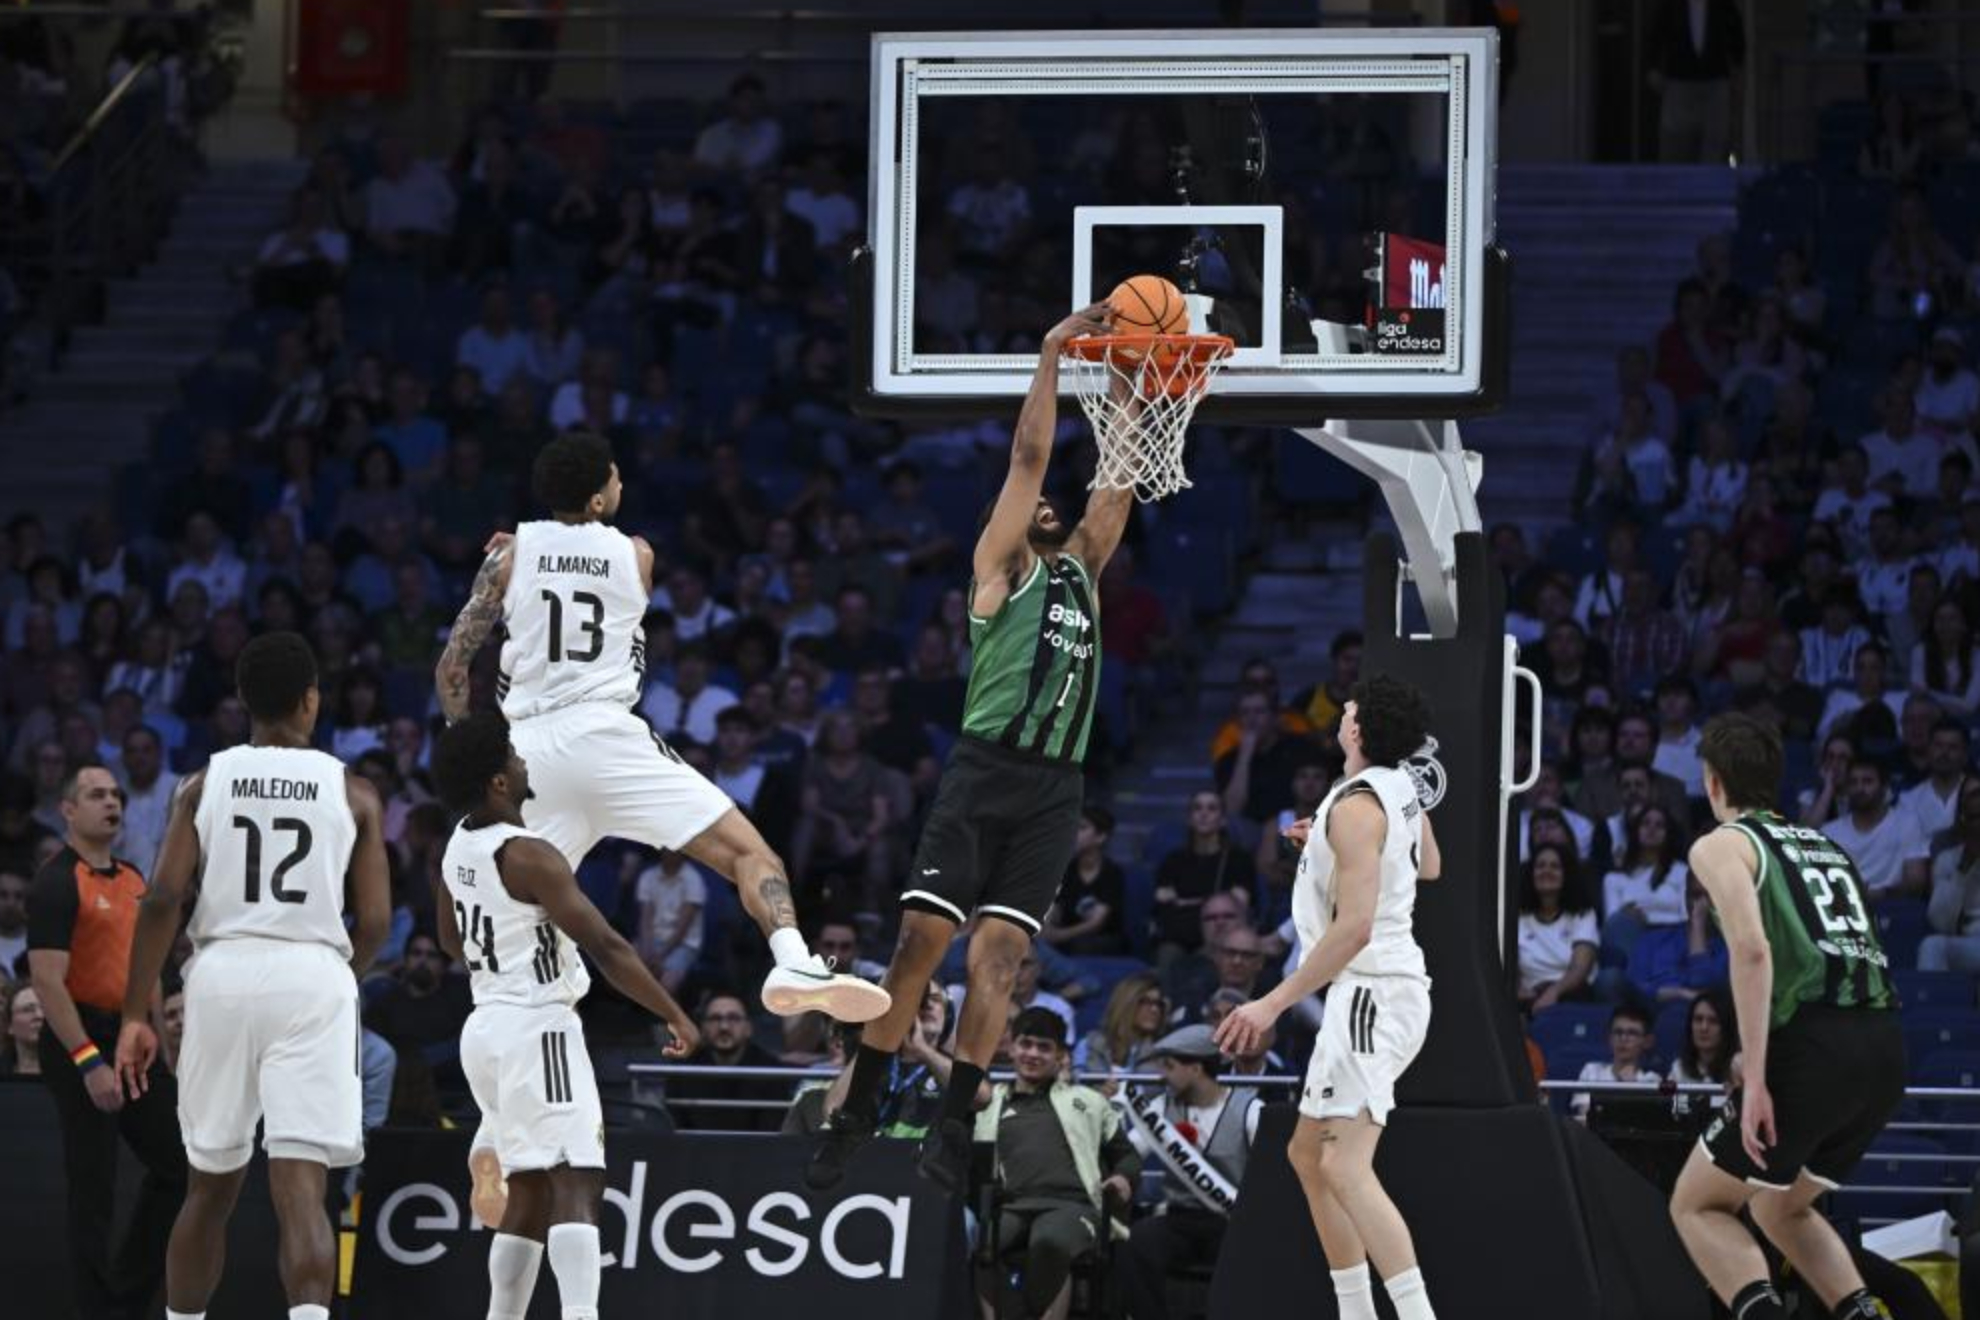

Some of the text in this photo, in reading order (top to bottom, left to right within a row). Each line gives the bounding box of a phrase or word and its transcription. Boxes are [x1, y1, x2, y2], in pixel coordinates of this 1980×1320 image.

[1378, 320, 1407, 336] liga
[1378, 336, 1441, 349] endesa
[537, 555, 610, 578] ALMANSA
[541, 589, 605, 662] 13
[1056, 672, 1075, 707] 1
[231, 777, 319, 801] MALEDON
[233, 815, 313, 904] 12
[1802, 868, 1869, 931] 23
[456, 901, 499, 973] 24
[375, 1161, 911, 1279] edesa
